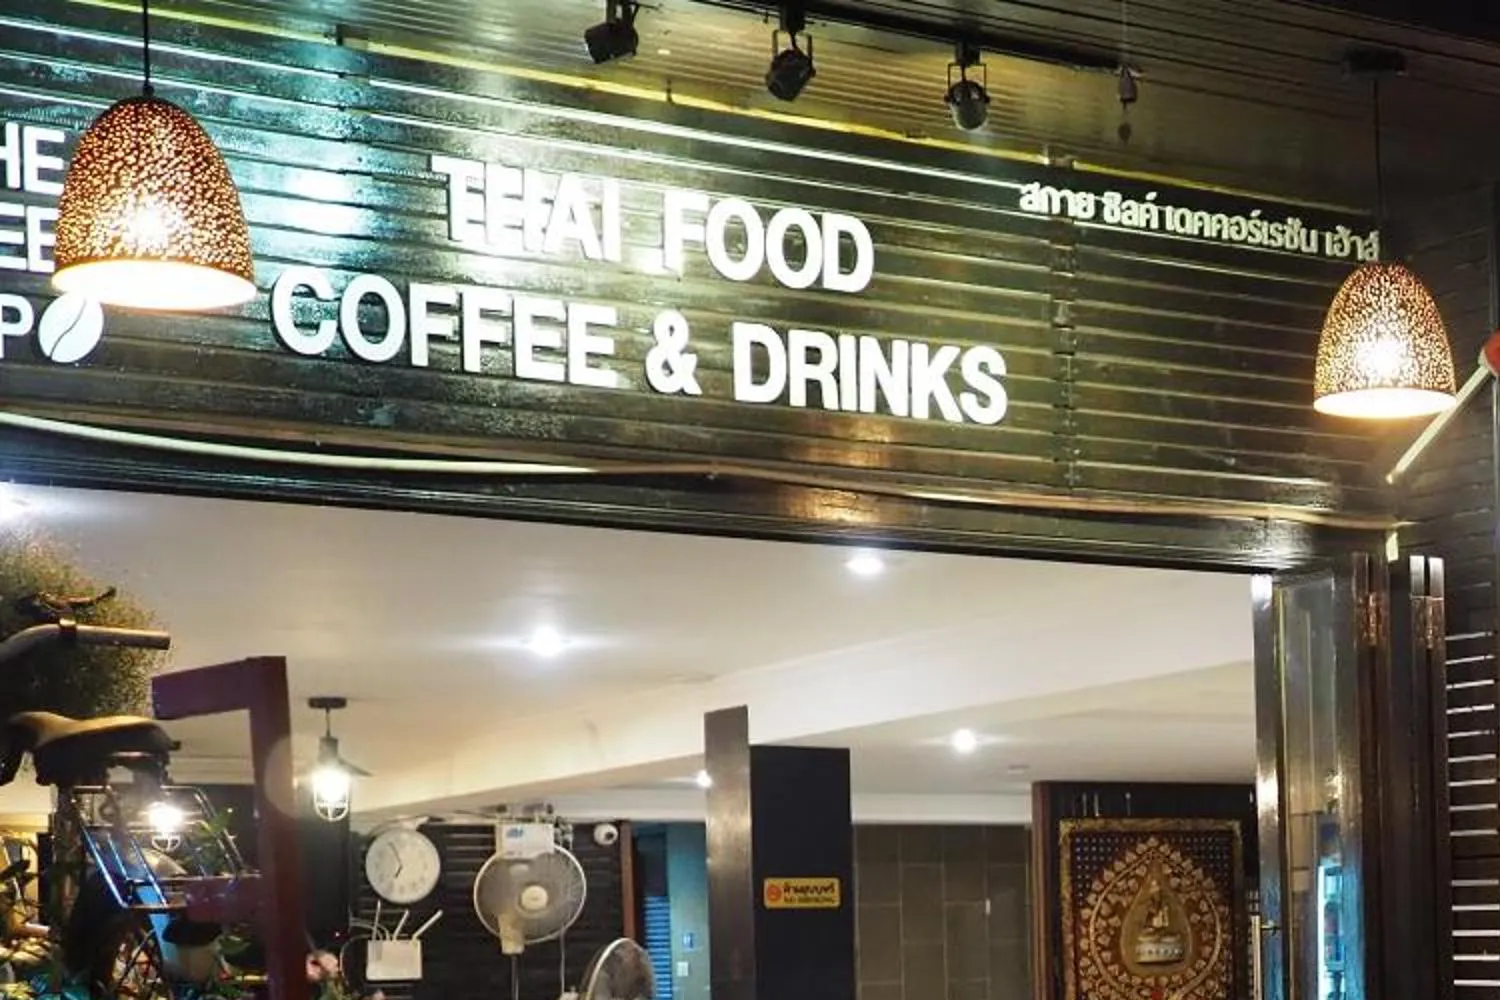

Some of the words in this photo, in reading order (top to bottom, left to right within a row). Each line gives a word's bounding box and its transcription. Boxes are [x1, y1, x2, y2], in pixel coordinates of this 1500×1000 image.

[431, 154, 622, 262] THAI
[662, 189, 875, 293] FOOD
[273, 266, 620, 389] COFFEE
[645, 309, 702, 396] &
[732, 321, 1008, 426] DRINKS
